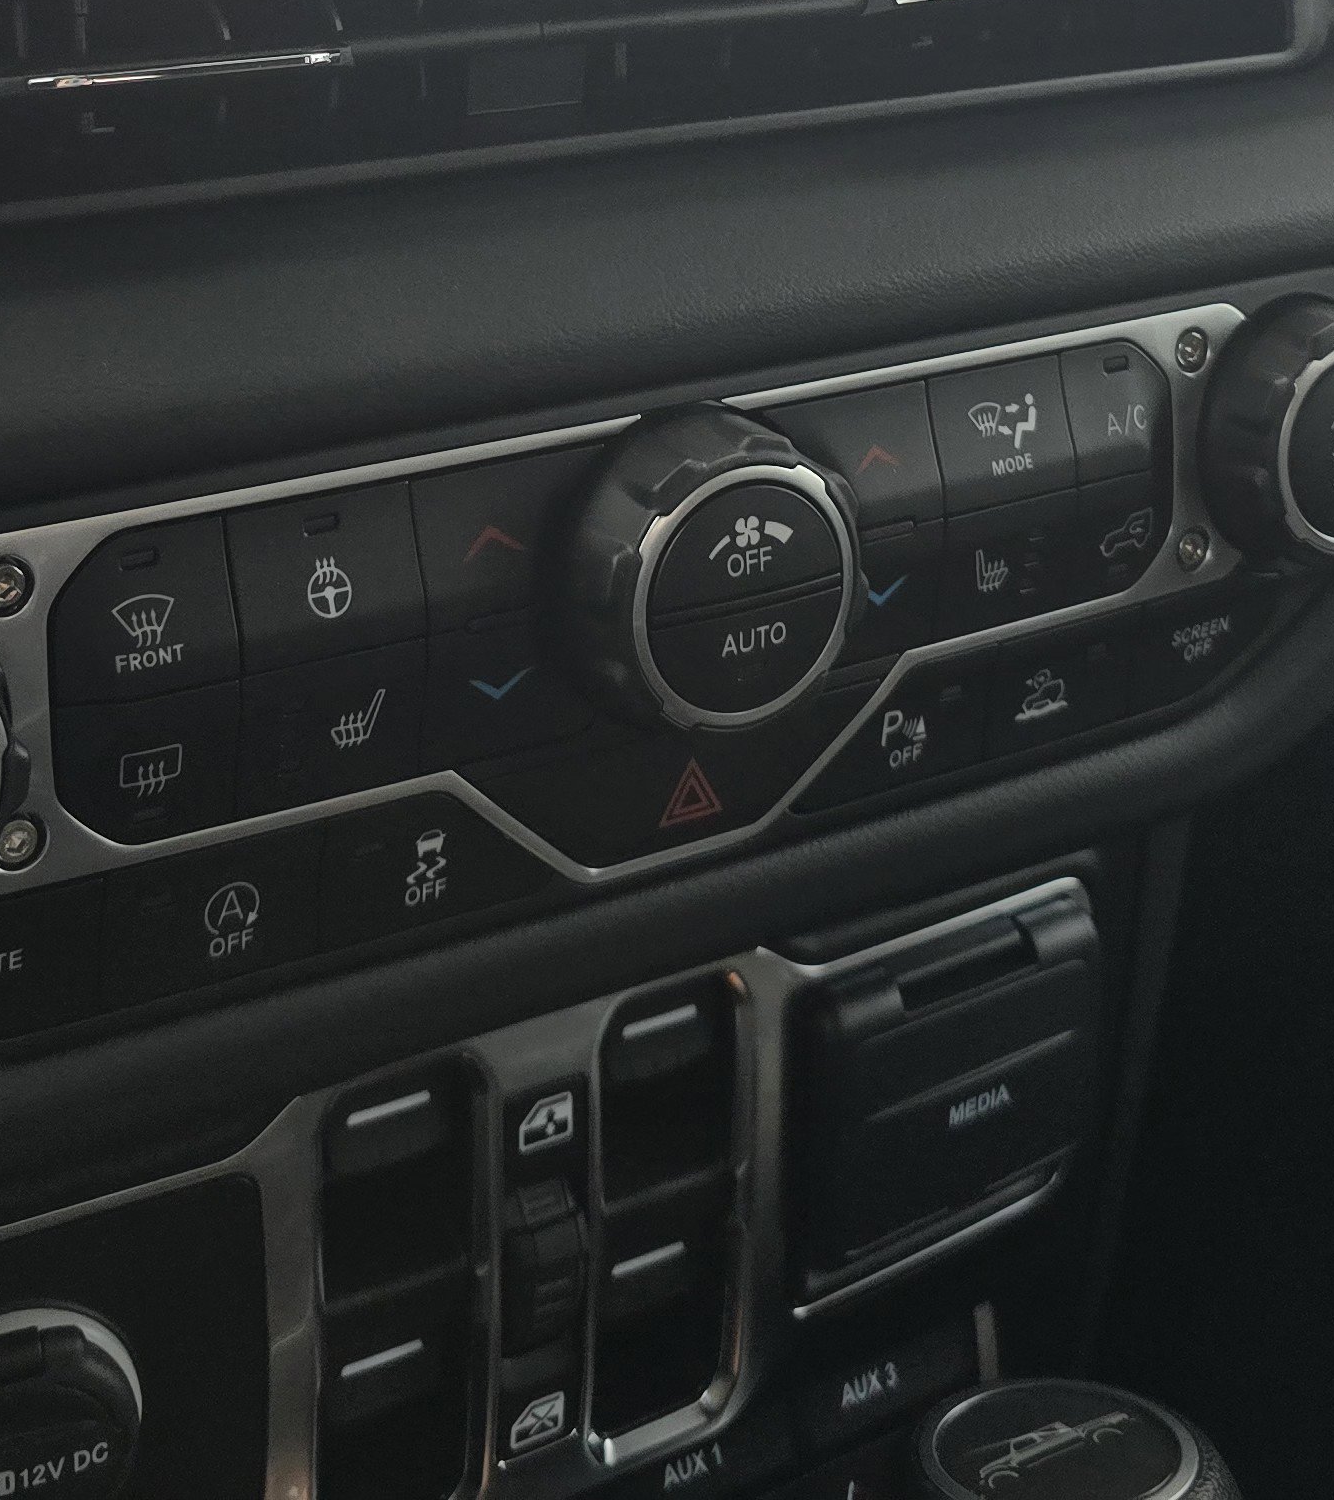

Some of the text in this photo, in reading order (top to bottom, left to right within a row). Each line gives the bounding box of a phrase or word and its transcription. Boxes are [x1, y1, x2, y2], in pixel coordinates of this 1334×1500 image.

[1107, 404, 1148, 435] A/C
[991, 453, 1034, 476] MODE
[726, 545, 773, 579] OFF
[721, 621, 788, 658] AUTO
[1171, 615, 1230, 648] SCREEN
[114, 643, 185, 674] FRONT
[1183, 639, 1212, 662] OFF
[888, 742, 923, 769] OFF
[405, 877, 448, 907] OFF
[209, 928, 255, 958] OFF
[948, 1084, 1009, 1128] MEDIA
[840, 1361, 899, 1408] AUX 3
[19, 1441, 110, 1489] 12V DC
[663, 1442, 724, 1489] AUX 1
